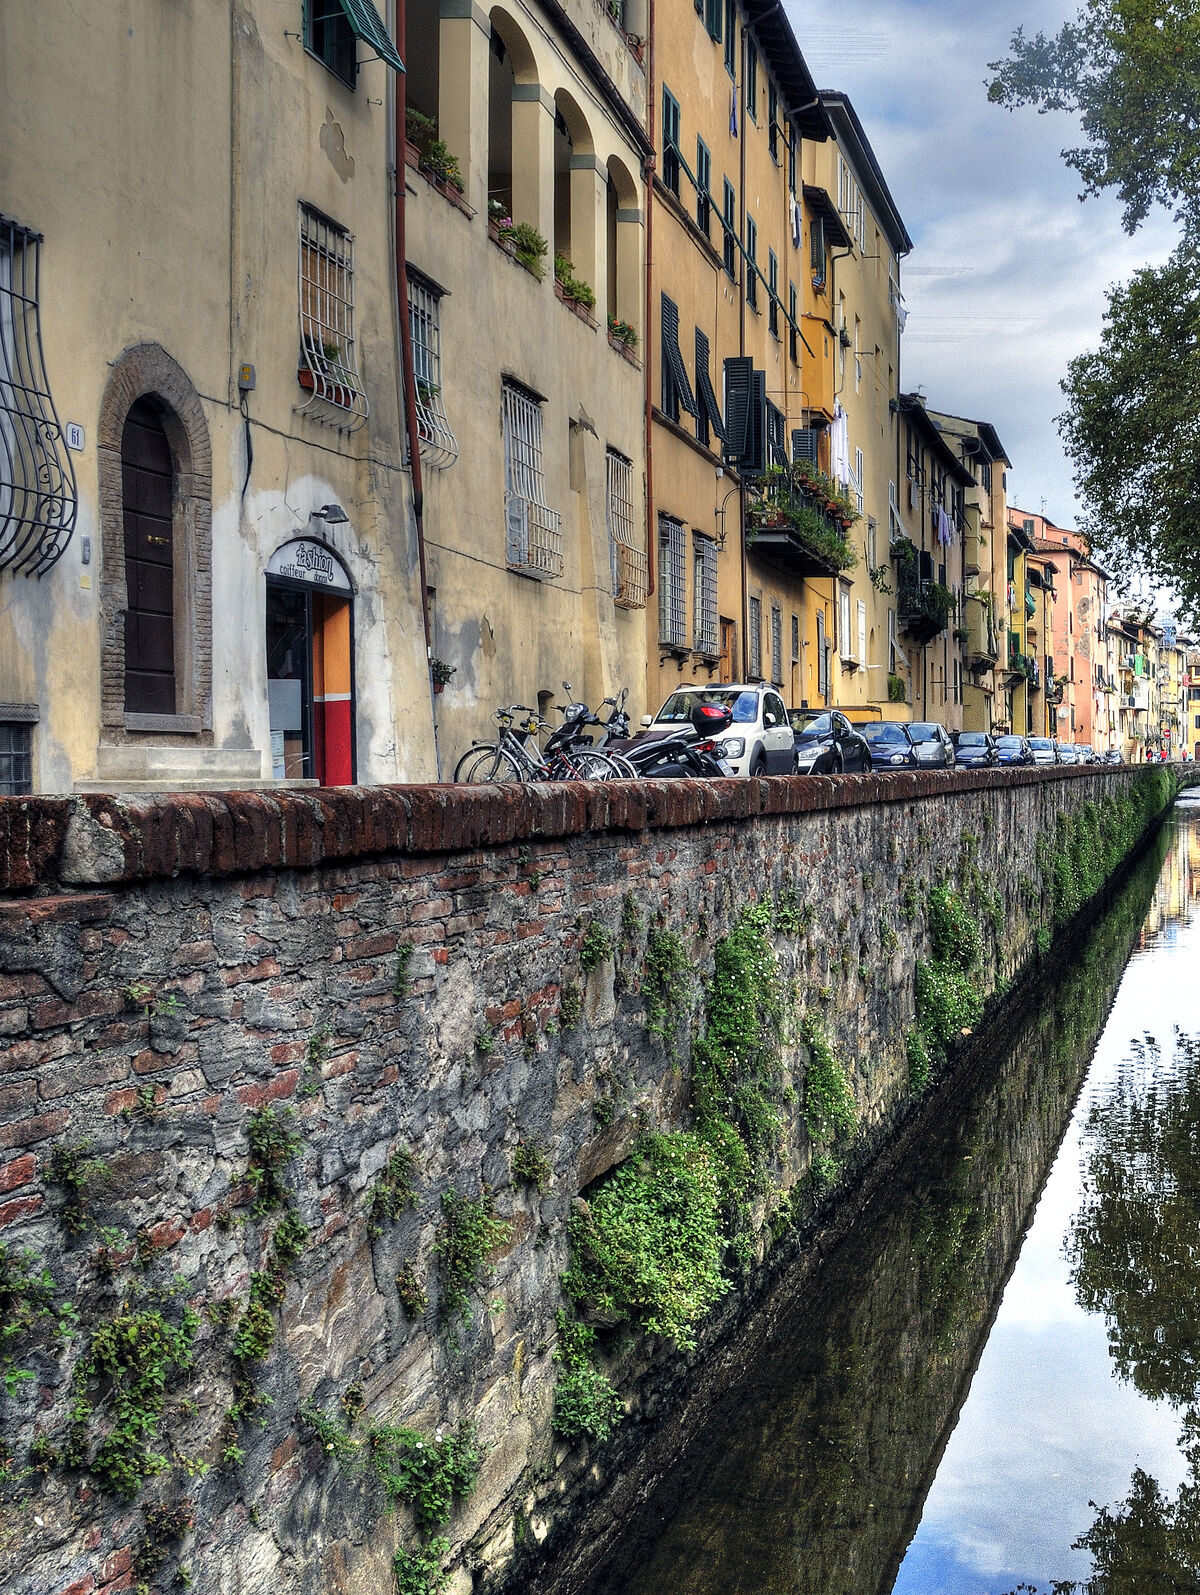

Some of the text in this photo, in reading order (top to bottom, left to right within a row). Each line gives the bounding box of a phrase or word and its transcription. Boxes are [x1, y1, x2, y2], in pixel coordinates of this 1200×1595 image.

[71, 428, 80, 446] 61
[280, 564, 306, 579] coiffeur
[296, 543, 334, 582] fashion
